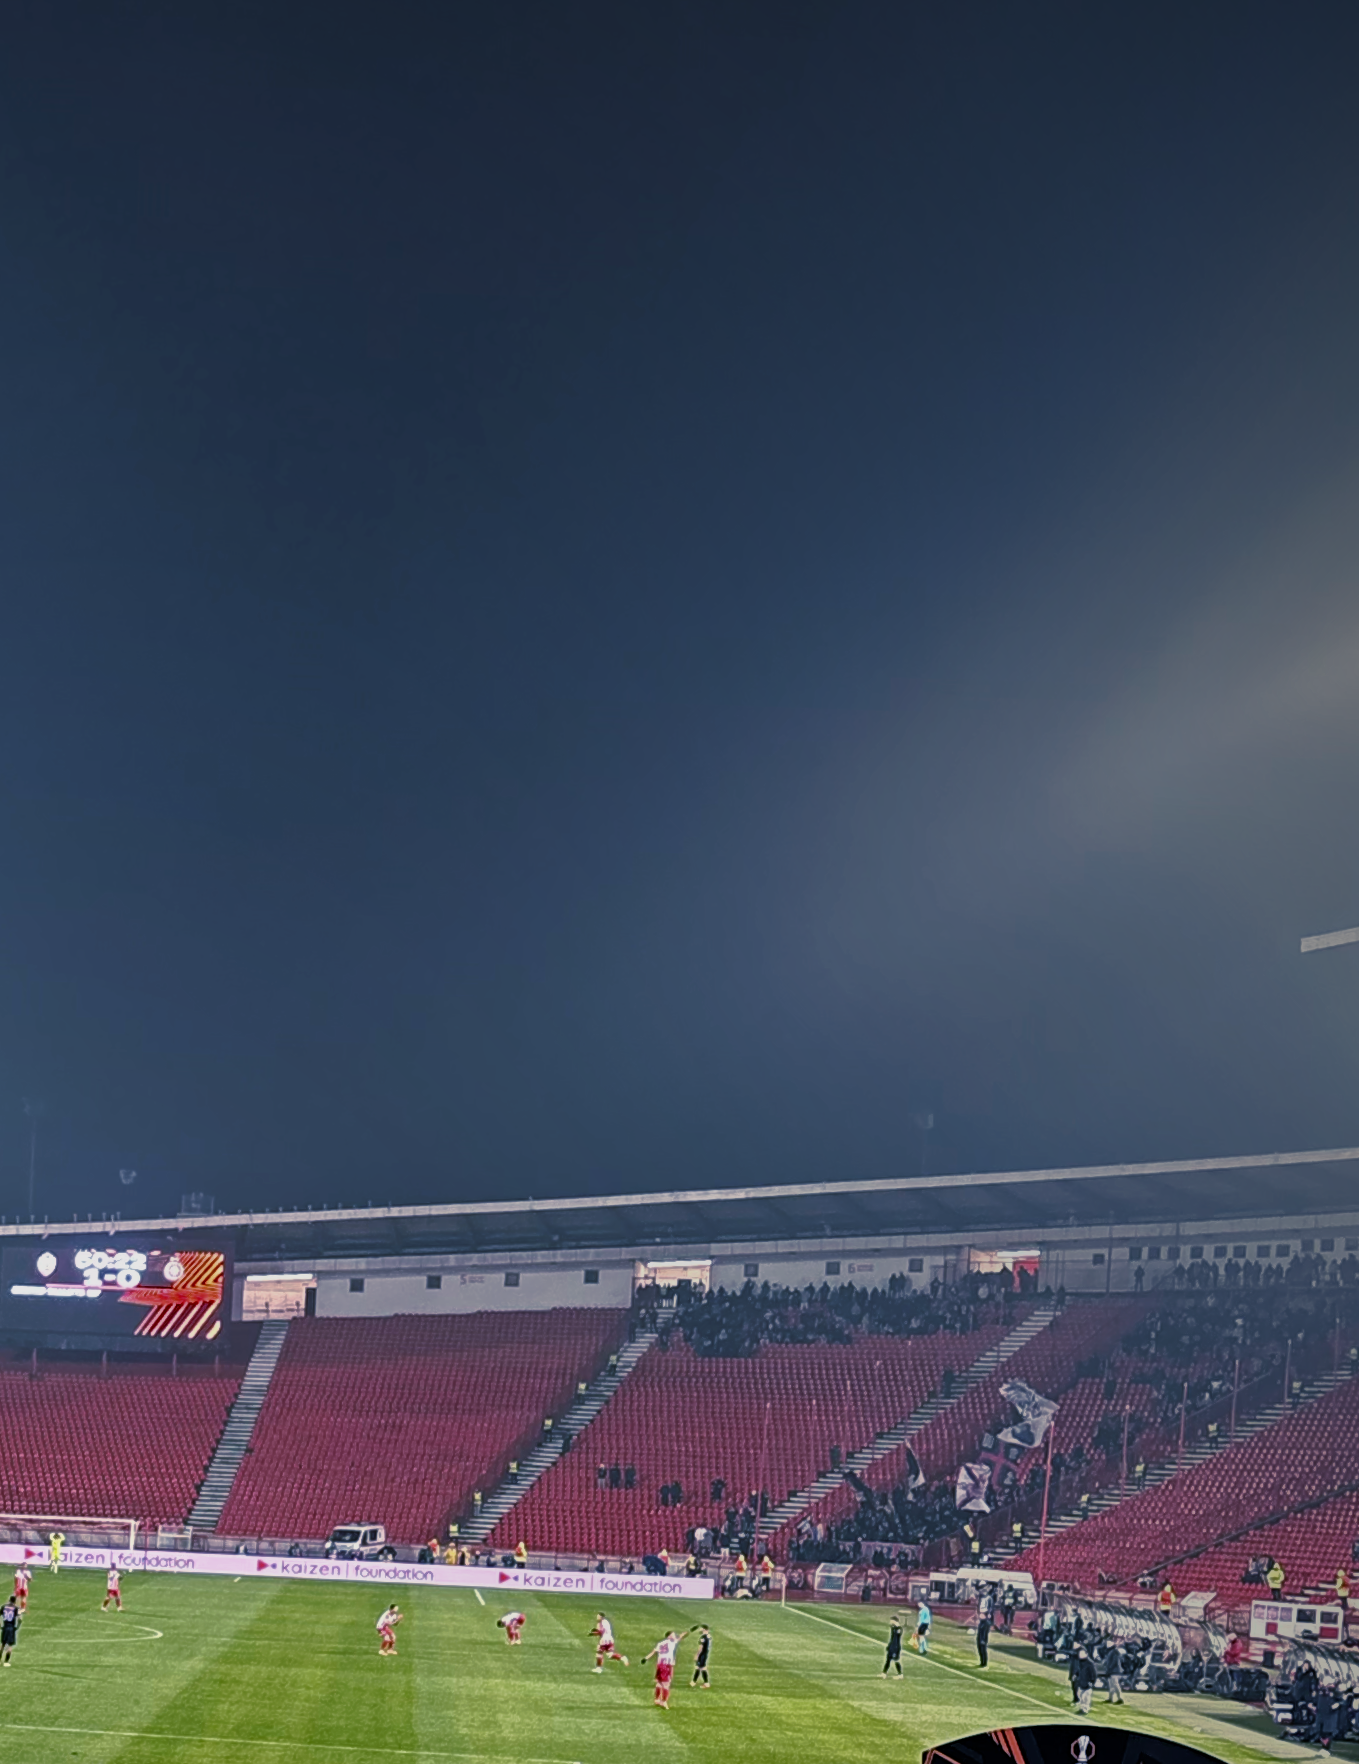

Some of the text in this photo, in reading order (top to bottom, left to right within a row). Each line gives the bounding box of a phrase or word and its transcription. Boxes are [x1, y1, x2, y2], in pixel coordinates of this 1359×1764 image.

[118, 1553, 194, 1570] foundation
[281, 1560, 434, 1581] kaizen foundation
[524, 1572, 682, 1594] kaizen foundation
